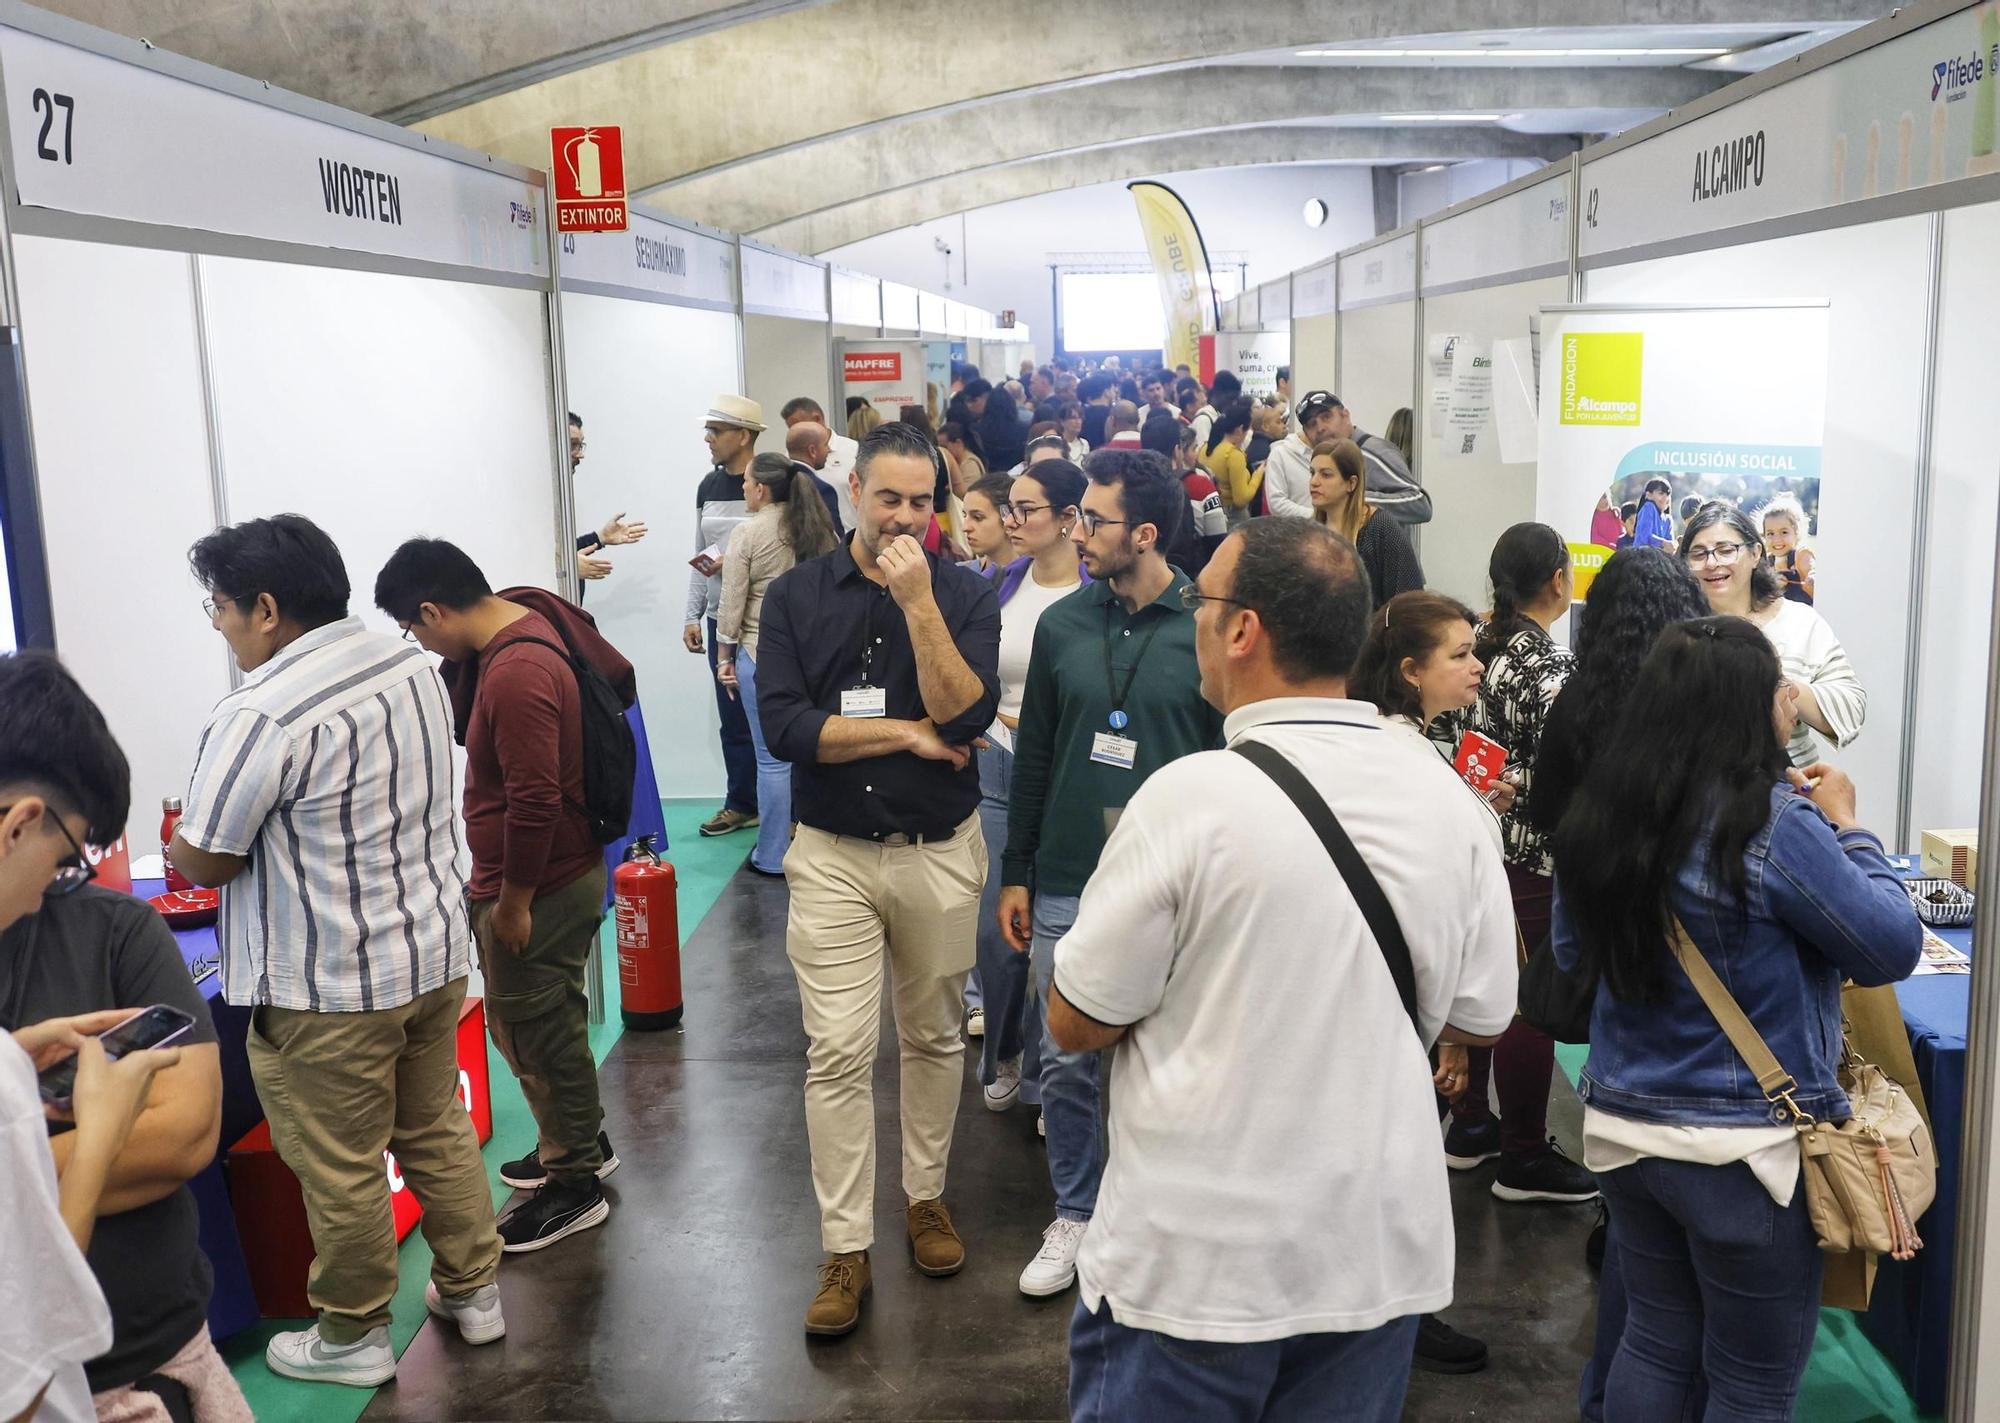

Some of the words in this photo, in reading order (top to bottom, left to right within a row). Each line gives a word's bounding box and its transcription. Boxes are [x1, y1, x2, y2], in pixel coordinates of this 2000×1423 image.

[1946, 51, 1983, 90] fifede
[32, 87, 75, 166] 27
[1692, 130, 1766, 202] ALCAMPO
[317, 156, 402, 227] WORTEN
[561, 207, 623, 225] EXTINTOR
[1586, 188, 1599, 229] 42
[635, 236, 687, 276] SEGURMÁXIMO
[844, 359, 894, 368] MAPFRE
[1239, 350, 1262, 361] Vive,
[1239, 365, 1266, 374] suma,
[1564, 338, 1577, 420] FUNDACION
[1577, 396, 1637, 414] Alcampo
[1654, 450, 1736, 469] INCLUSIÓN
[1740, 454, 1797, 471] SOCIAL
[1572, 553, 1602, 568] LUD
